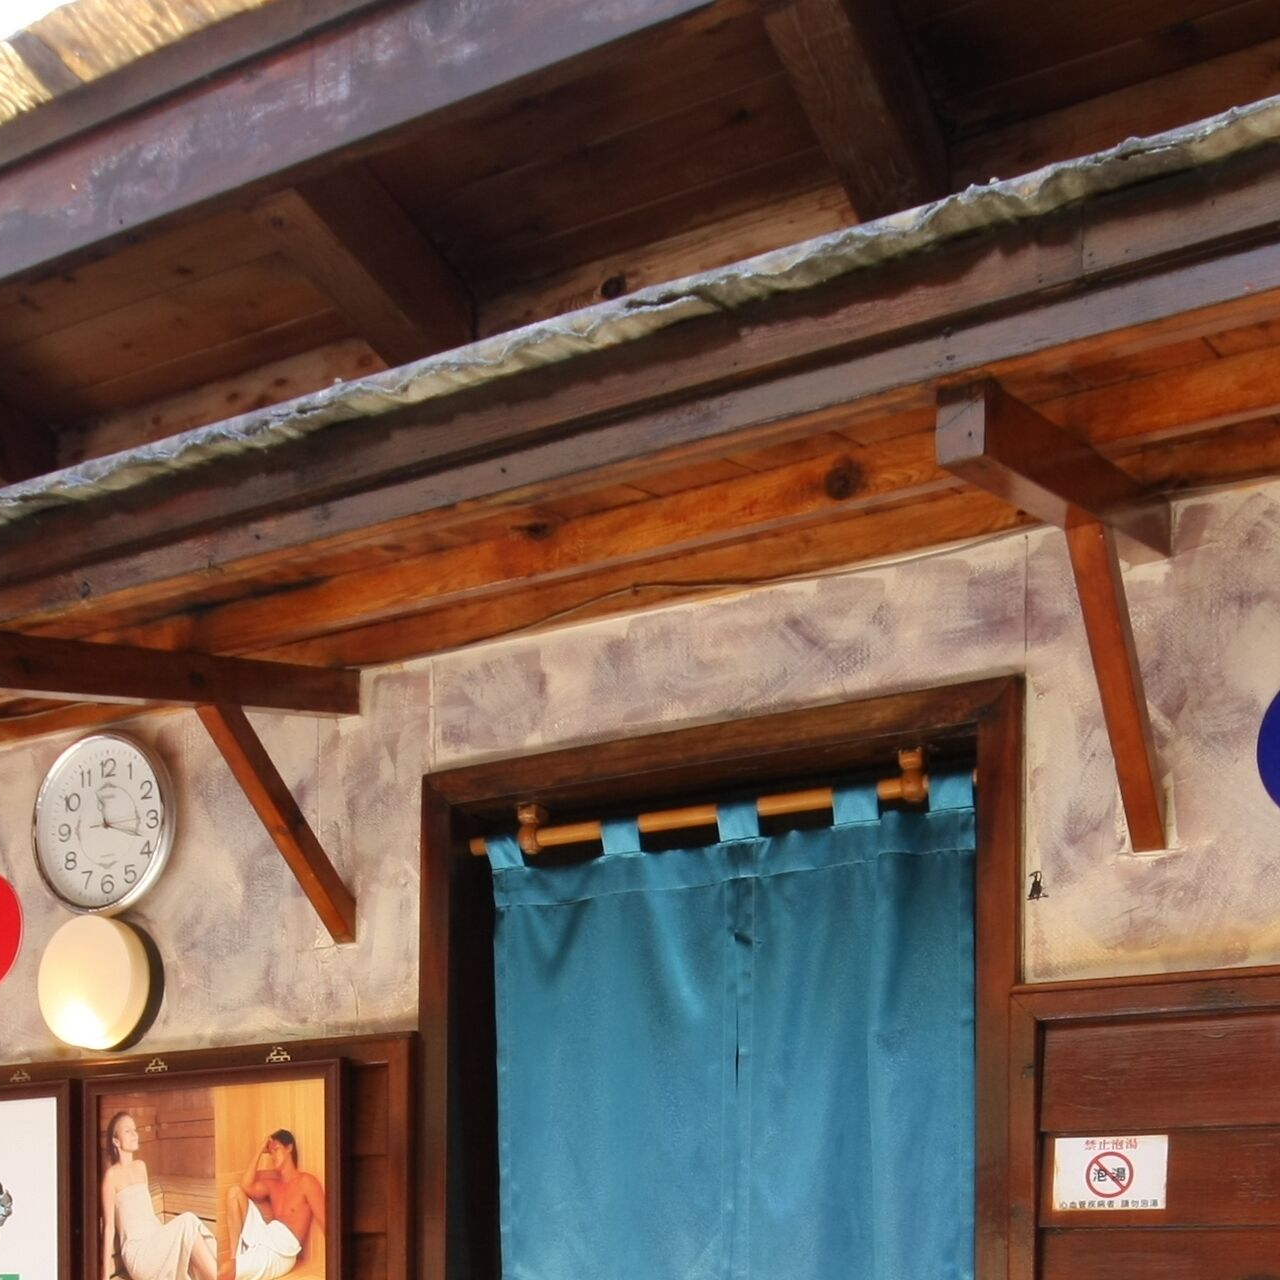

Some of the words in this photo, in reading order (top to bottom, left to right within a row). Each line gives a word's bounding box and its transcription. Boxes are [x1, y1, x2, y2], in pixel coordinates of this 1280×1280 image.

[100, 757, 117, 778] 12
[128, 762, 133, 780] 1
[80, 768, 91, 788] 11
[140, 780, 153, 800] 2
[64, 792, 81, 812] 10
[145, 809, 159, 829] 3
[58, 823, 71, 842] 9
[139, 840, 153, 858] 4
[64, 851, 77, 870] 8
[81, 870, 93, 890] 7
[100, 874, 114, 894] 6
[124, 864, 137, 884] 5
[1084, 1138, 1138, 1150] 禁止泡湯
